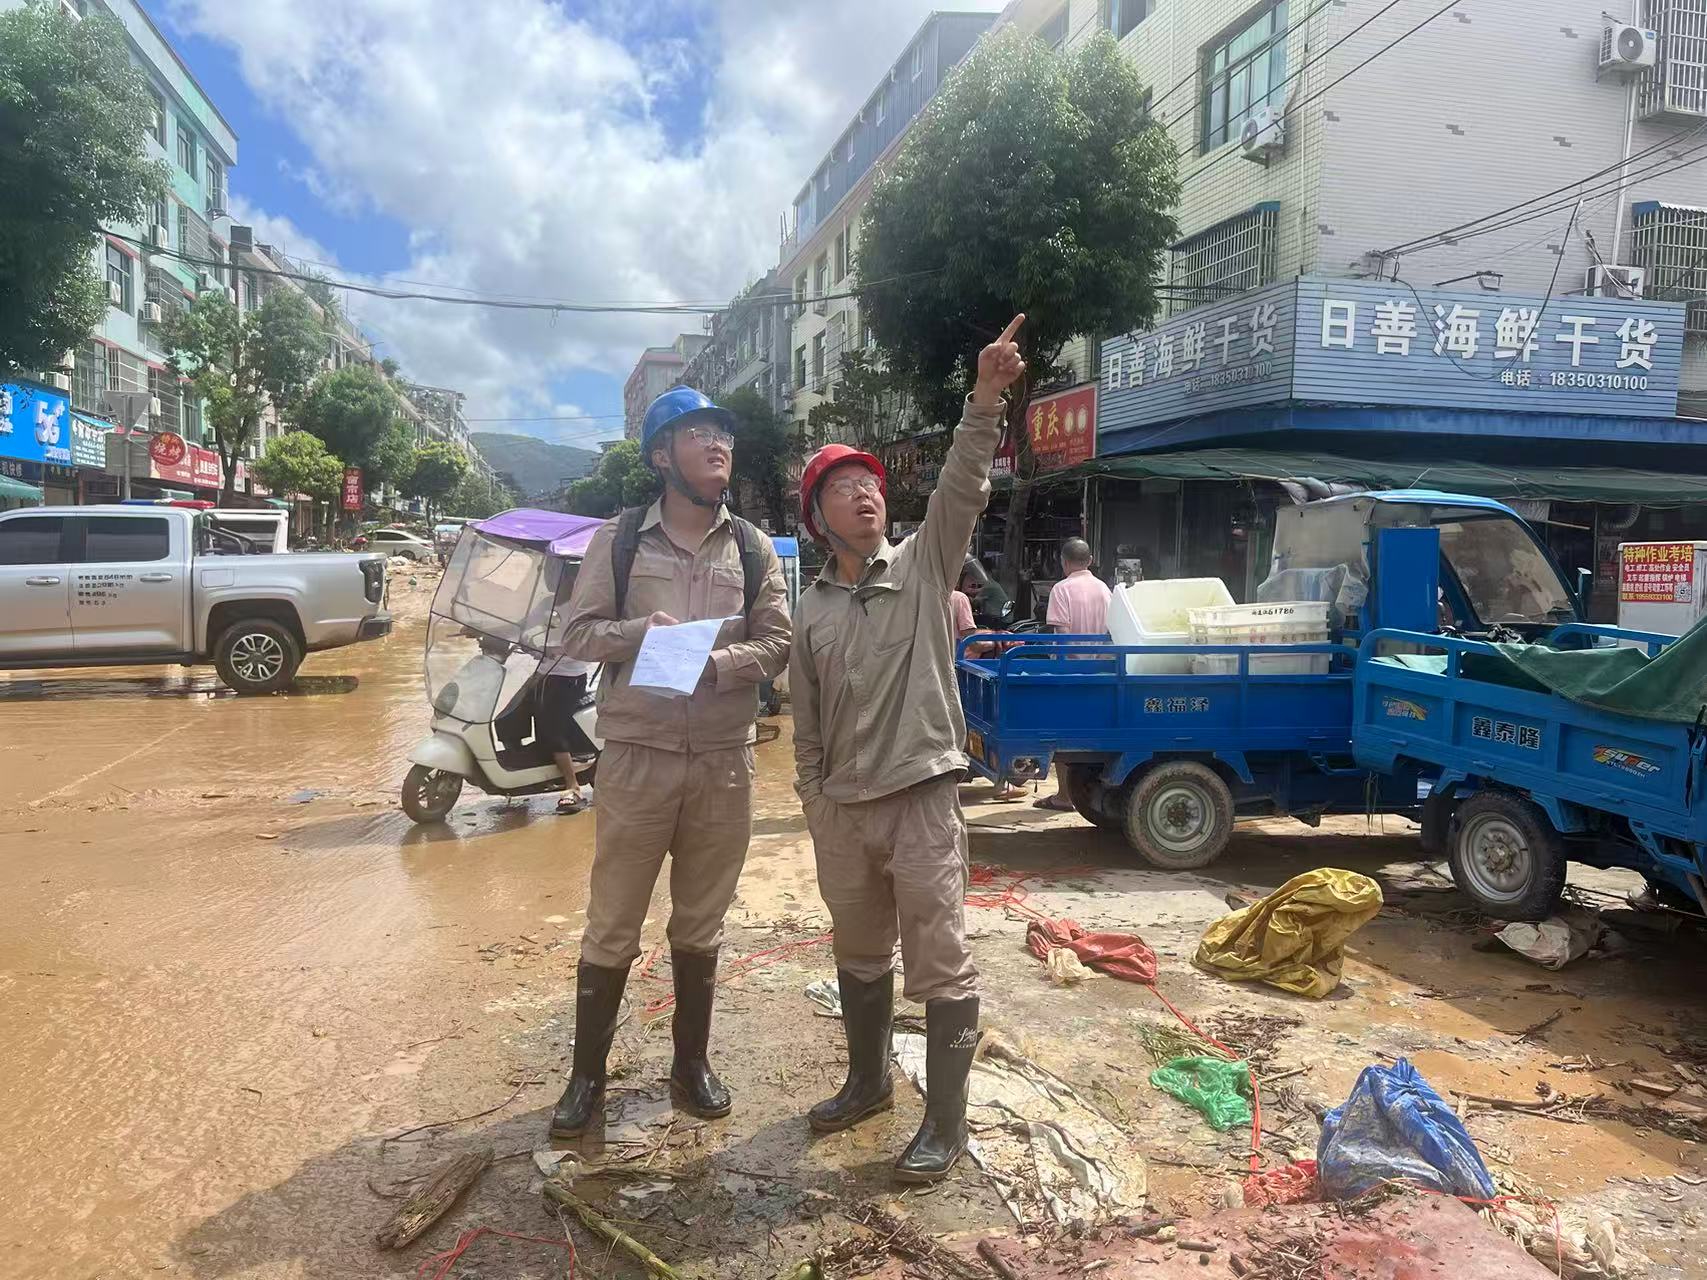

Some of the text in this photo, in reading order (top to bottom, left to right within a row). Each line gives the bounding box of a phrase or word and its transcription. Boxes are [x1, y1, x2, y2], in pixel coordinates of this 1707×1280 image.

[1108, 303, 1277, 391] 日善海鲜干货
[1320, 298, 1658, 370] 日善海鲜干货
[1623, 546, 1693, 563] 特种作业考培
[1471, 716, 1540, 750] 鑫泰隆
